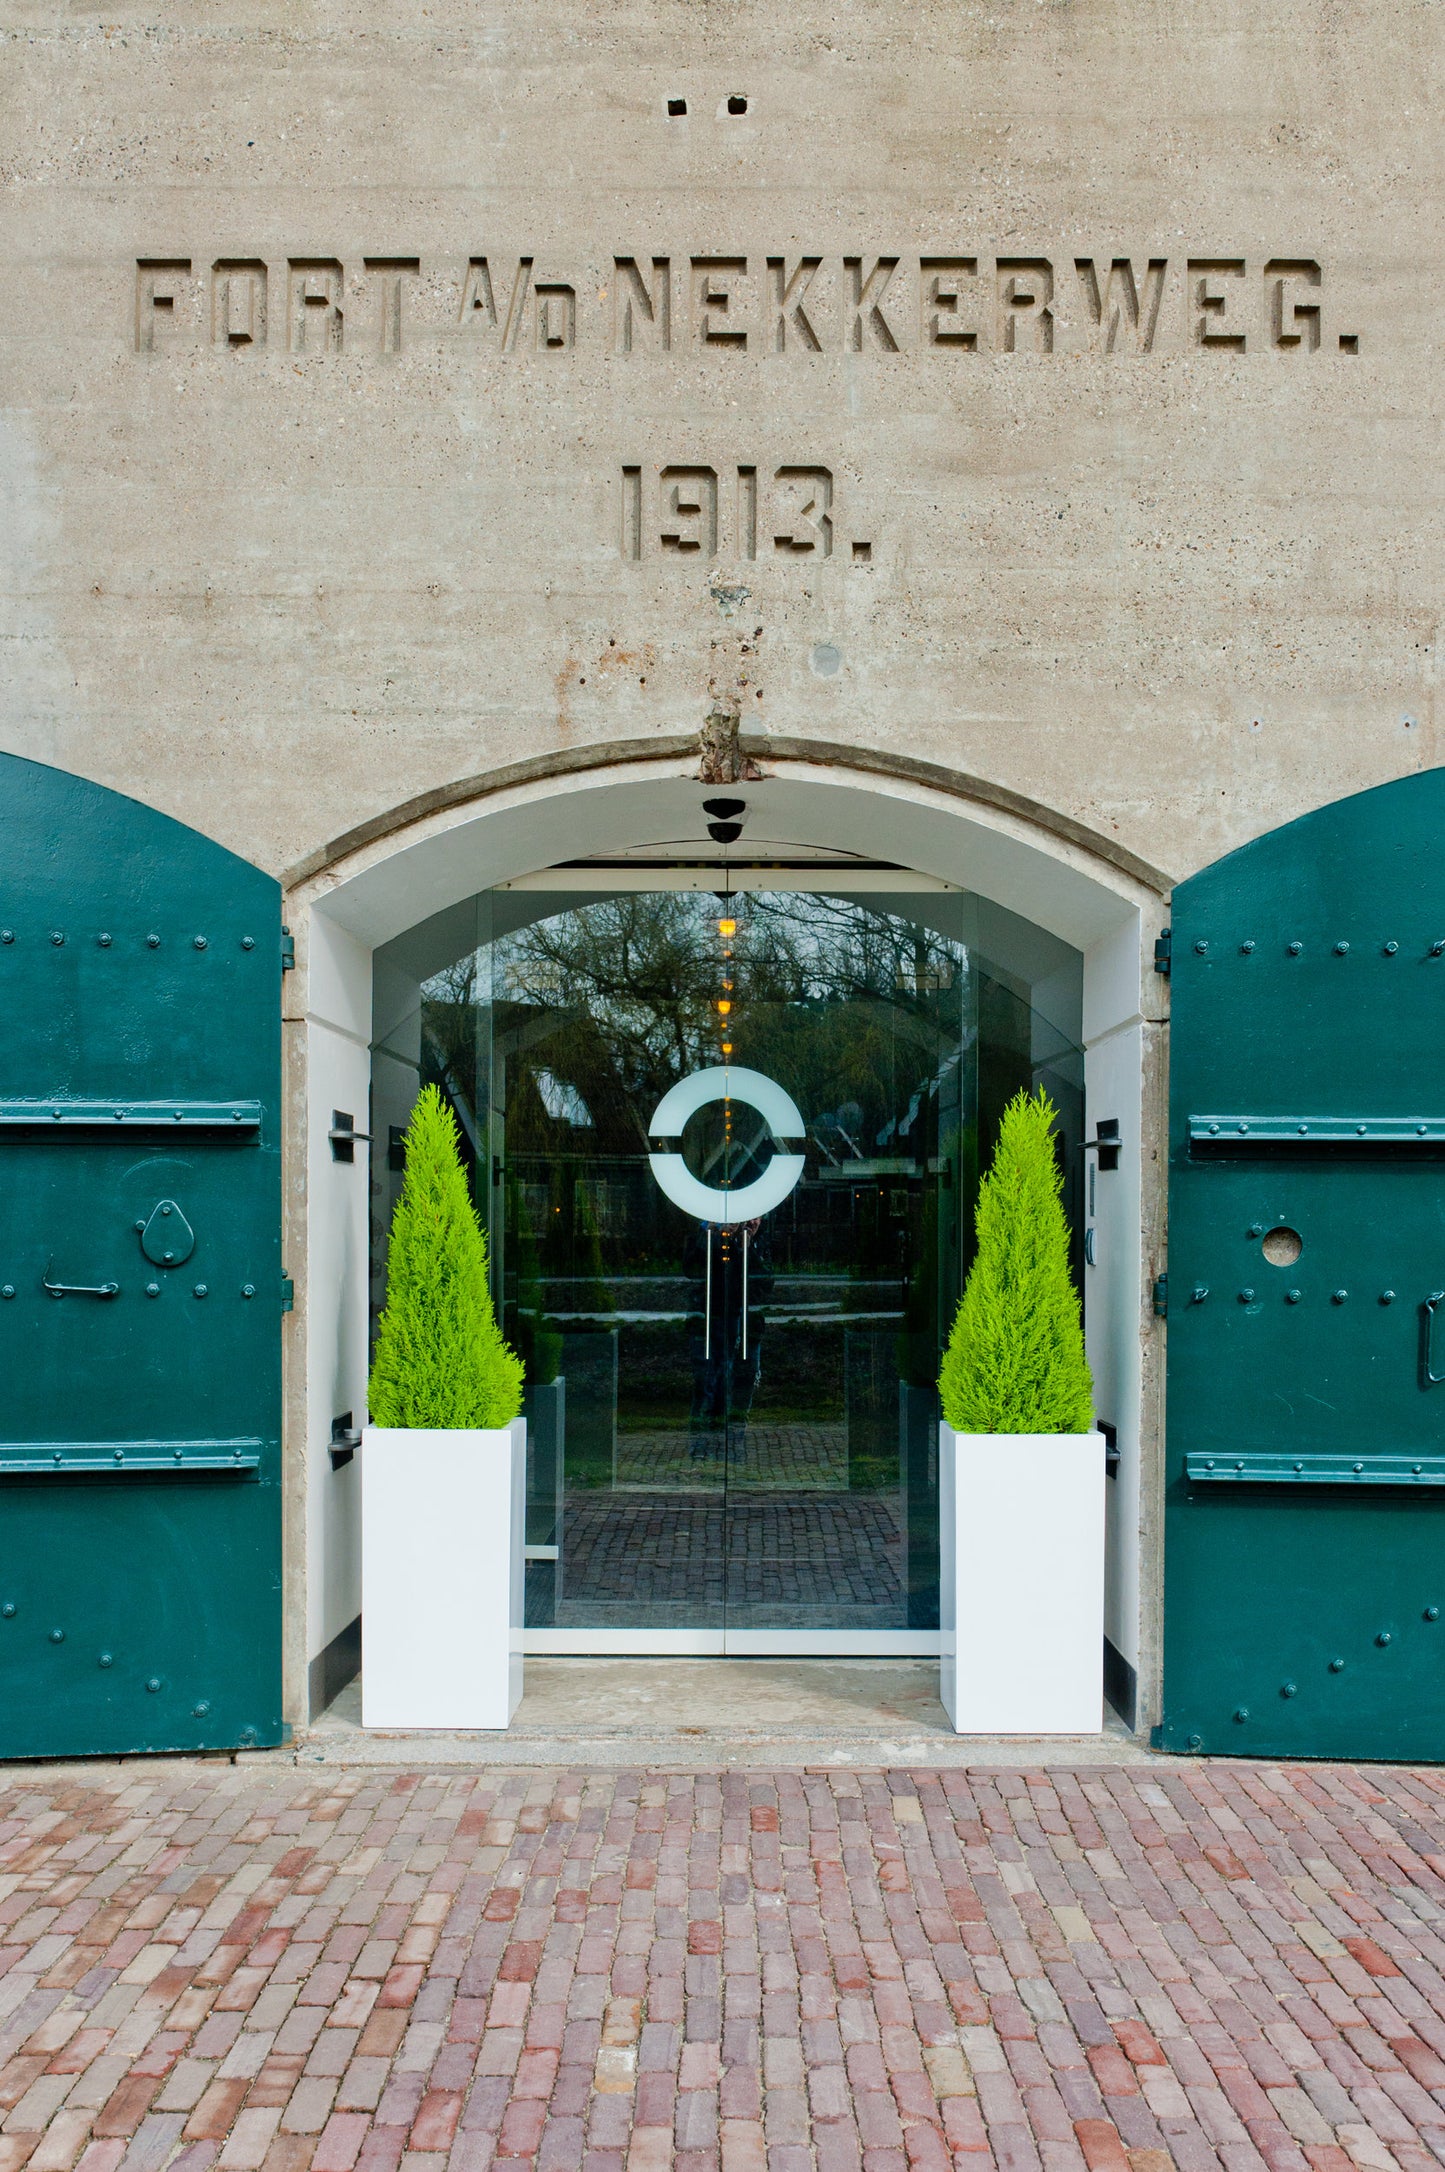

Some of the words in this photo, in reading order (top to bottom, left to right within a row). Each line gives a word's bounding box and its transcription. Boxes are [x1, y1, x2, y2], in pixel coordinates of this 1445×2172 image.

[135, 257, 421, 354] FORT
[613, 256, 1358, 355] NEKKERWEG.
[620, 465, 872, 561] 1913.
